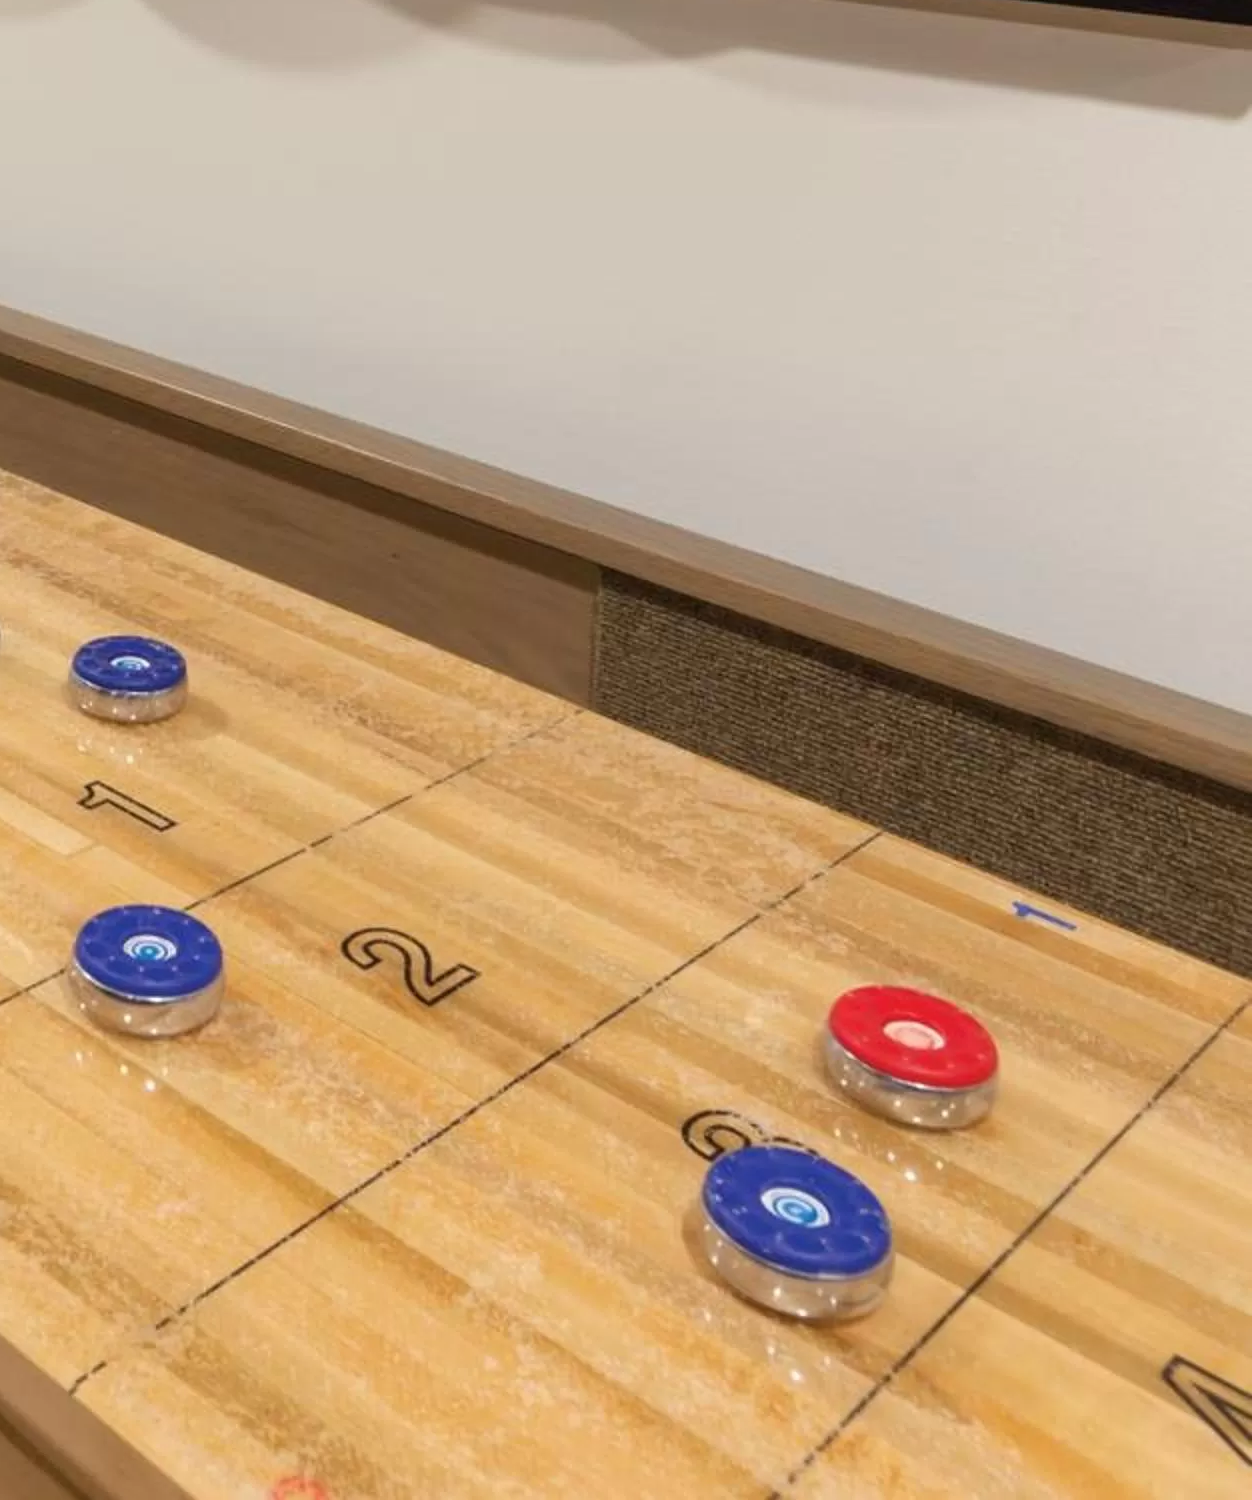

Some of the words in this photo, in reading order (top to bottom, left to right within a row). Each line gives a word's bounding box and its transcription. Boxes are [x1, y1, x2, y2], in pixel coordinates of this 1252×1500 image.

[76, 779, 178, 833] 1
[1011, 900, 1078, 931] 1
[340, 926, 482, 1008] 2
